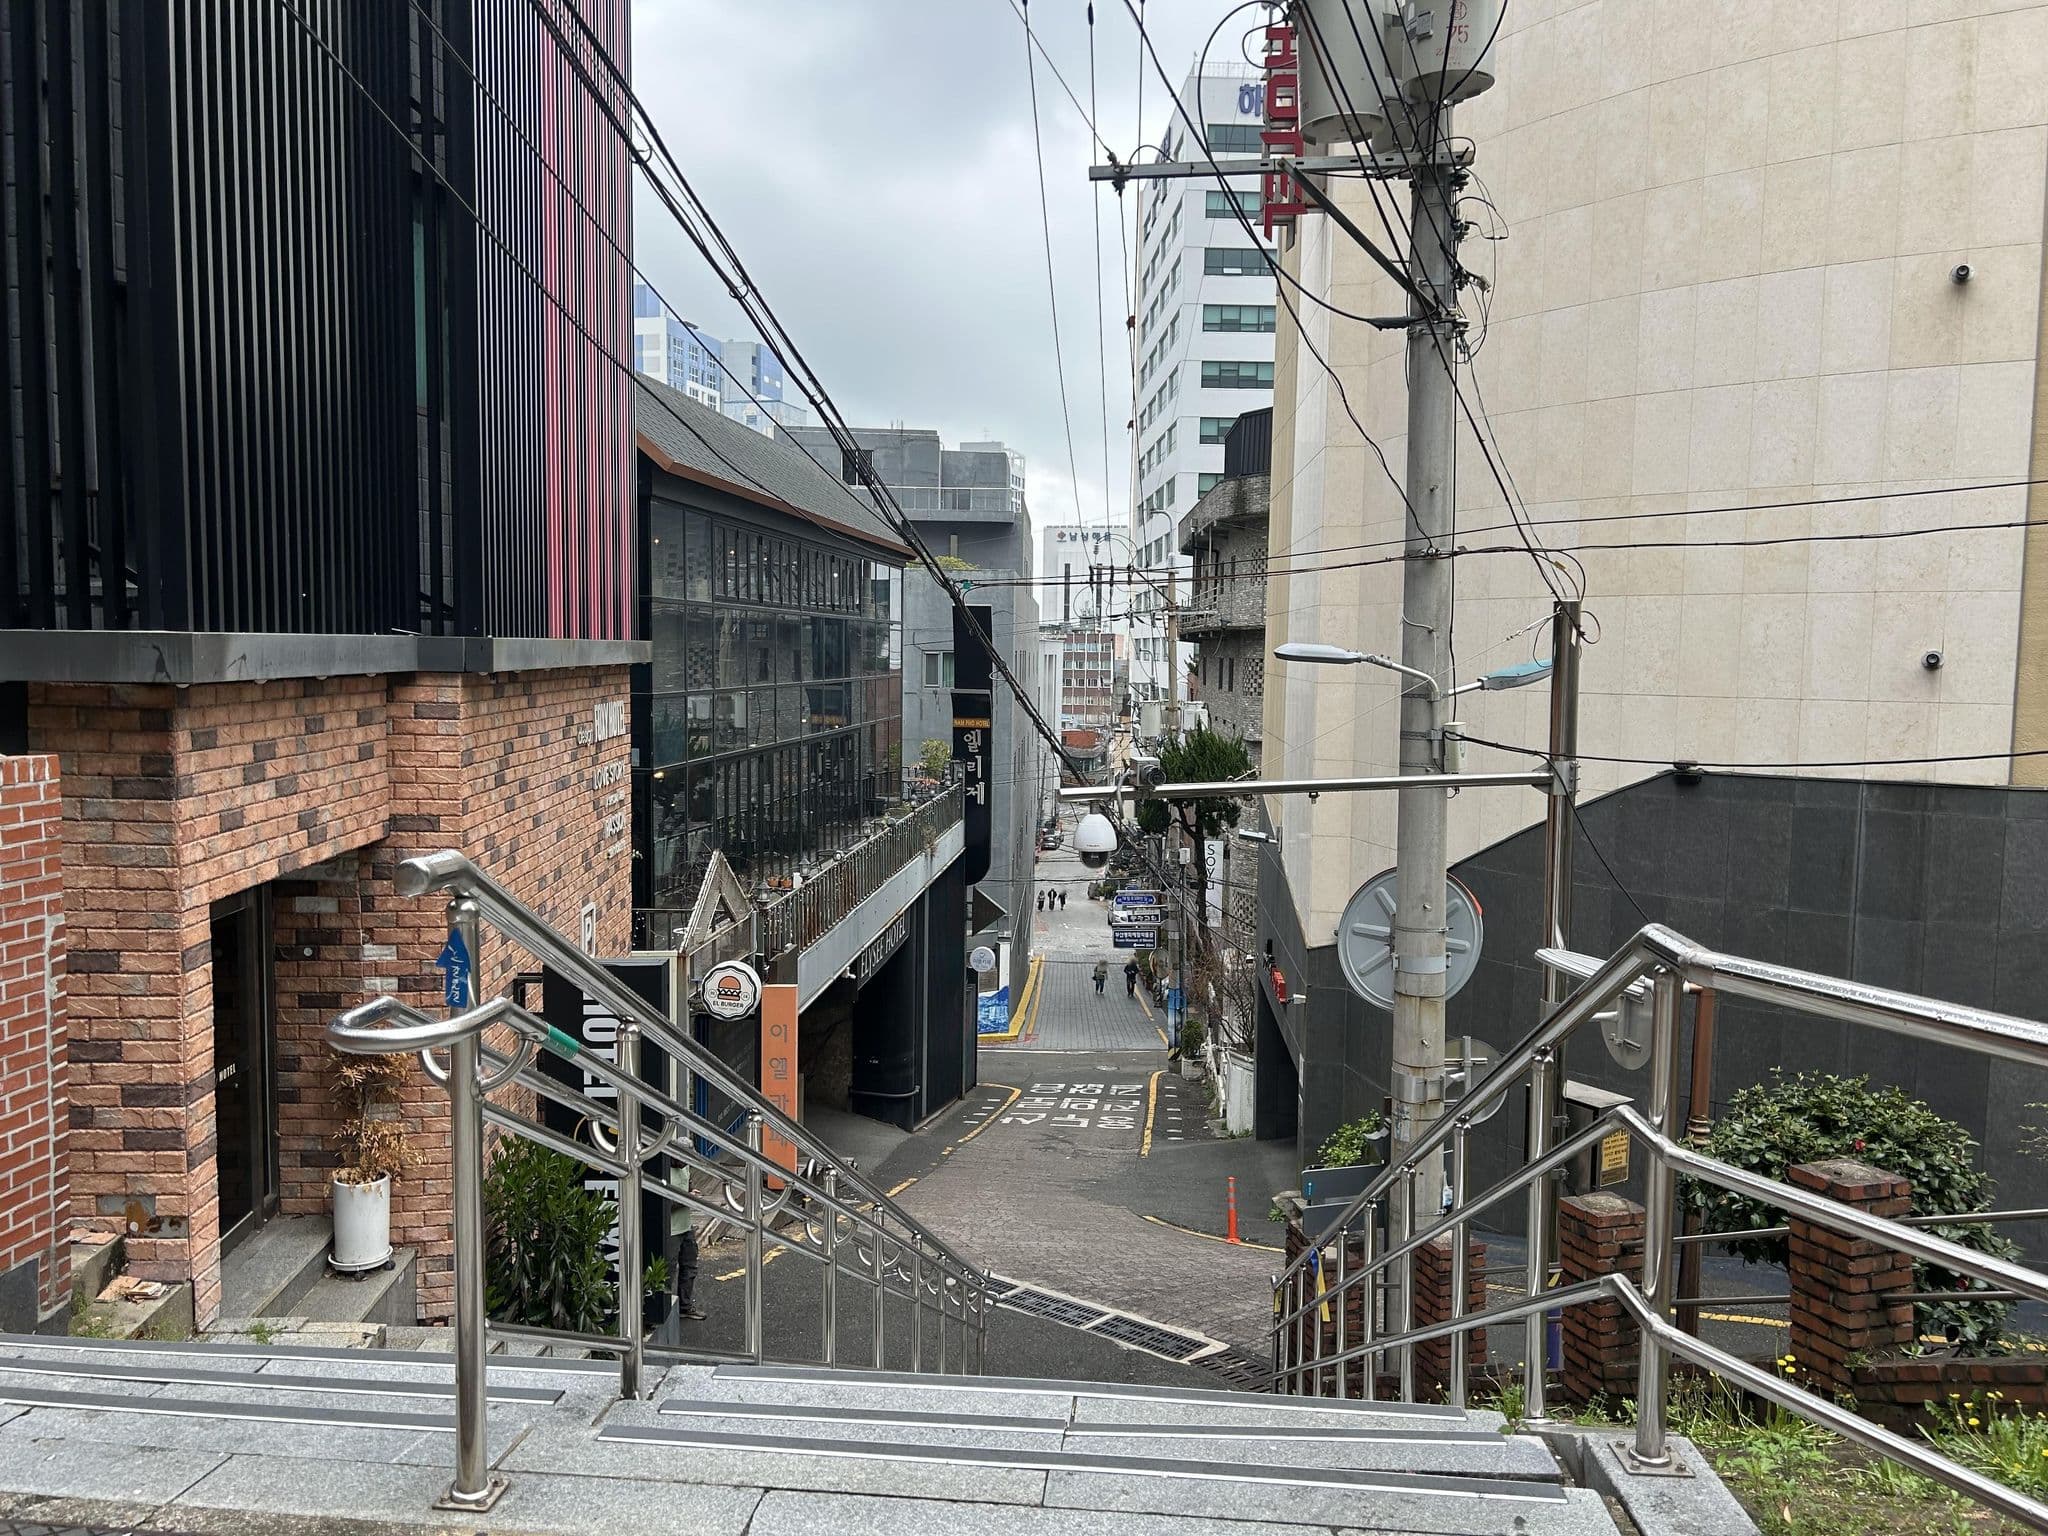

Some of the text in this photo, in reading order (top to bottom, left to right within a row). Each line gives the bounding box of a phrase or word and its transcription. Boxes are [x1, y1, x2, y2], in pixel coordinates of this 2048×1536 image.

[963, 729, 985, 805] 엘리제
[885, 912, 906, 953] HOTEL
[219, 1063, 236, 1082] HOTEL
[1015, 1097, 1140, 1112] 진입로
[1000, 1112, 1136, 1130] 용두산
